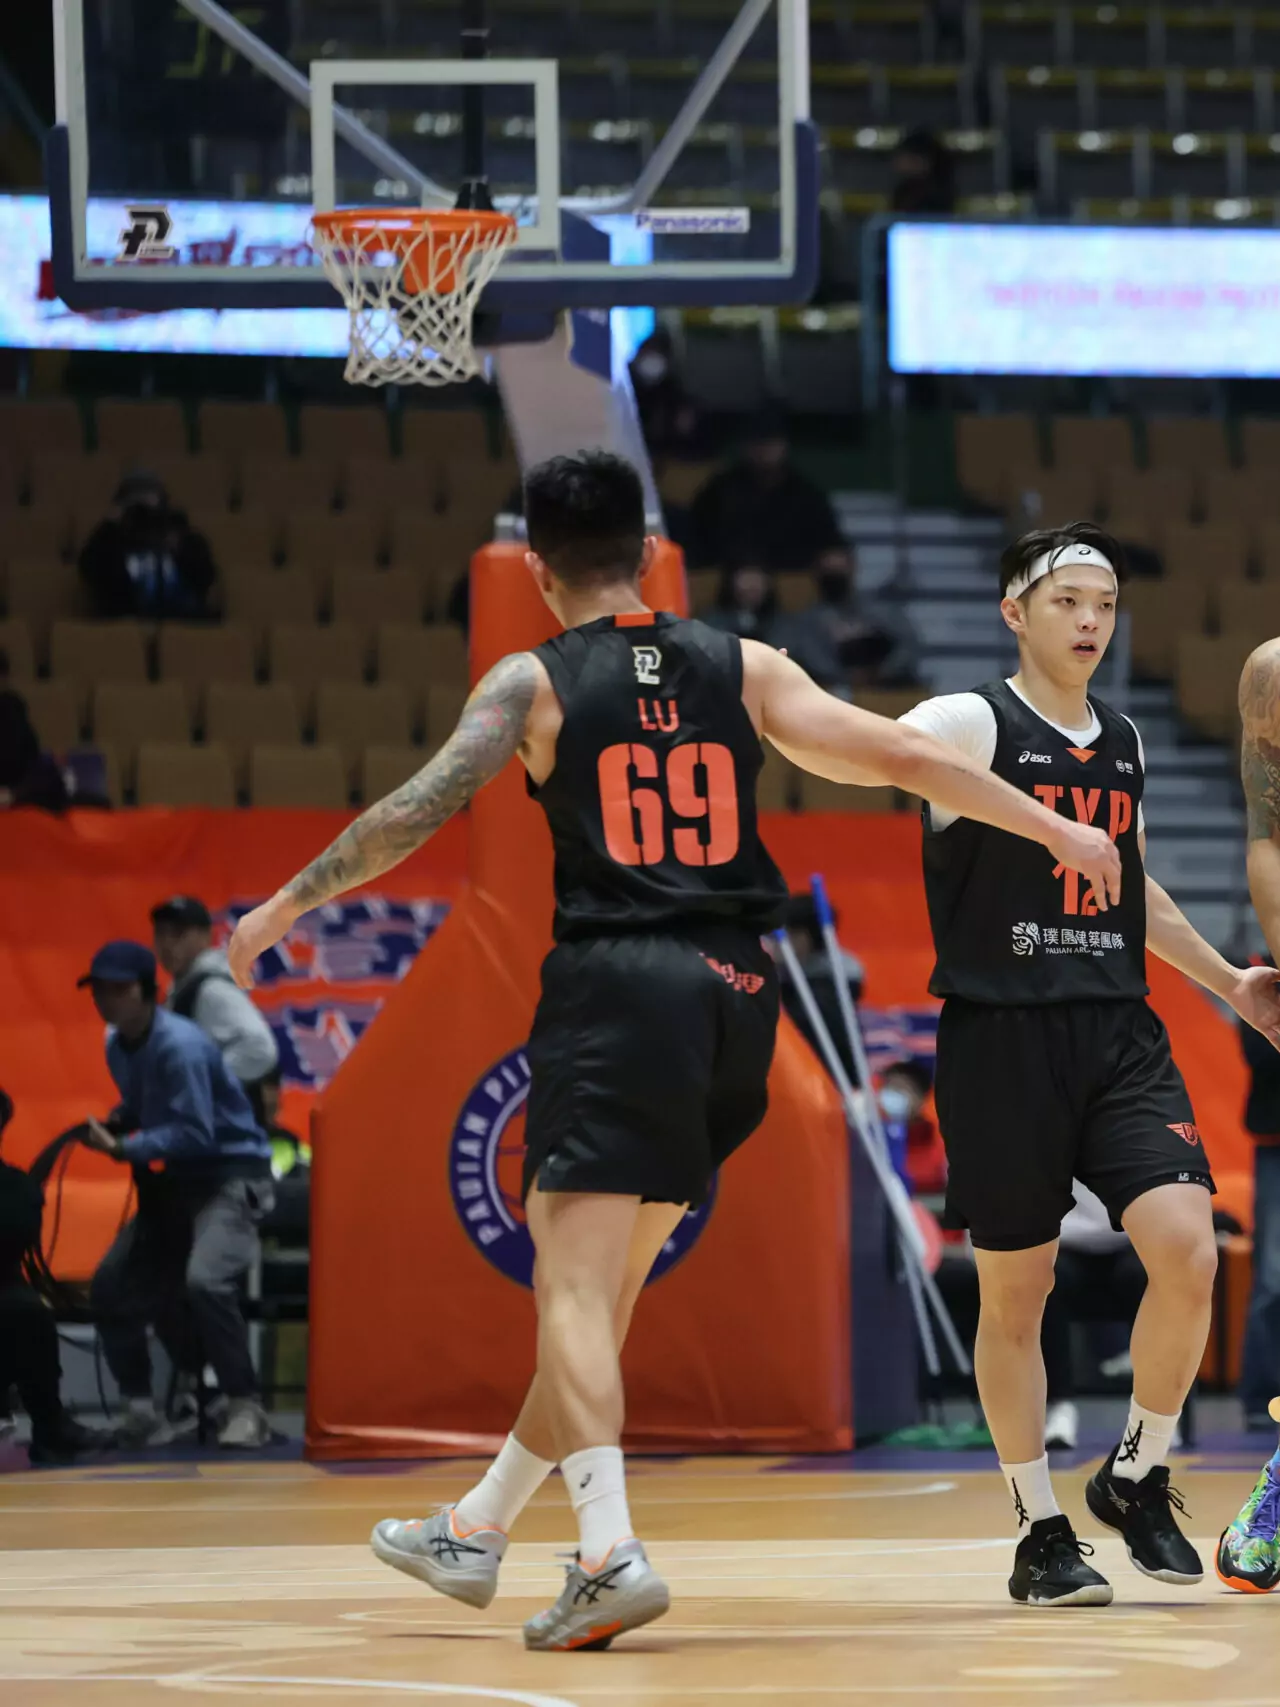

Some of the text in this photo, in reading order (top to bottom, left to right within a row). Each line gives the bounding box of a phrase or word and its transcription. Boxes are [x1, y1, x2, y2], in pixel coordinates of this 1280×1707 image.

[637, 698, 680, 732] LU
[1030, 754, 1052, 764] asics
[597, 742, 740, 866] 69
